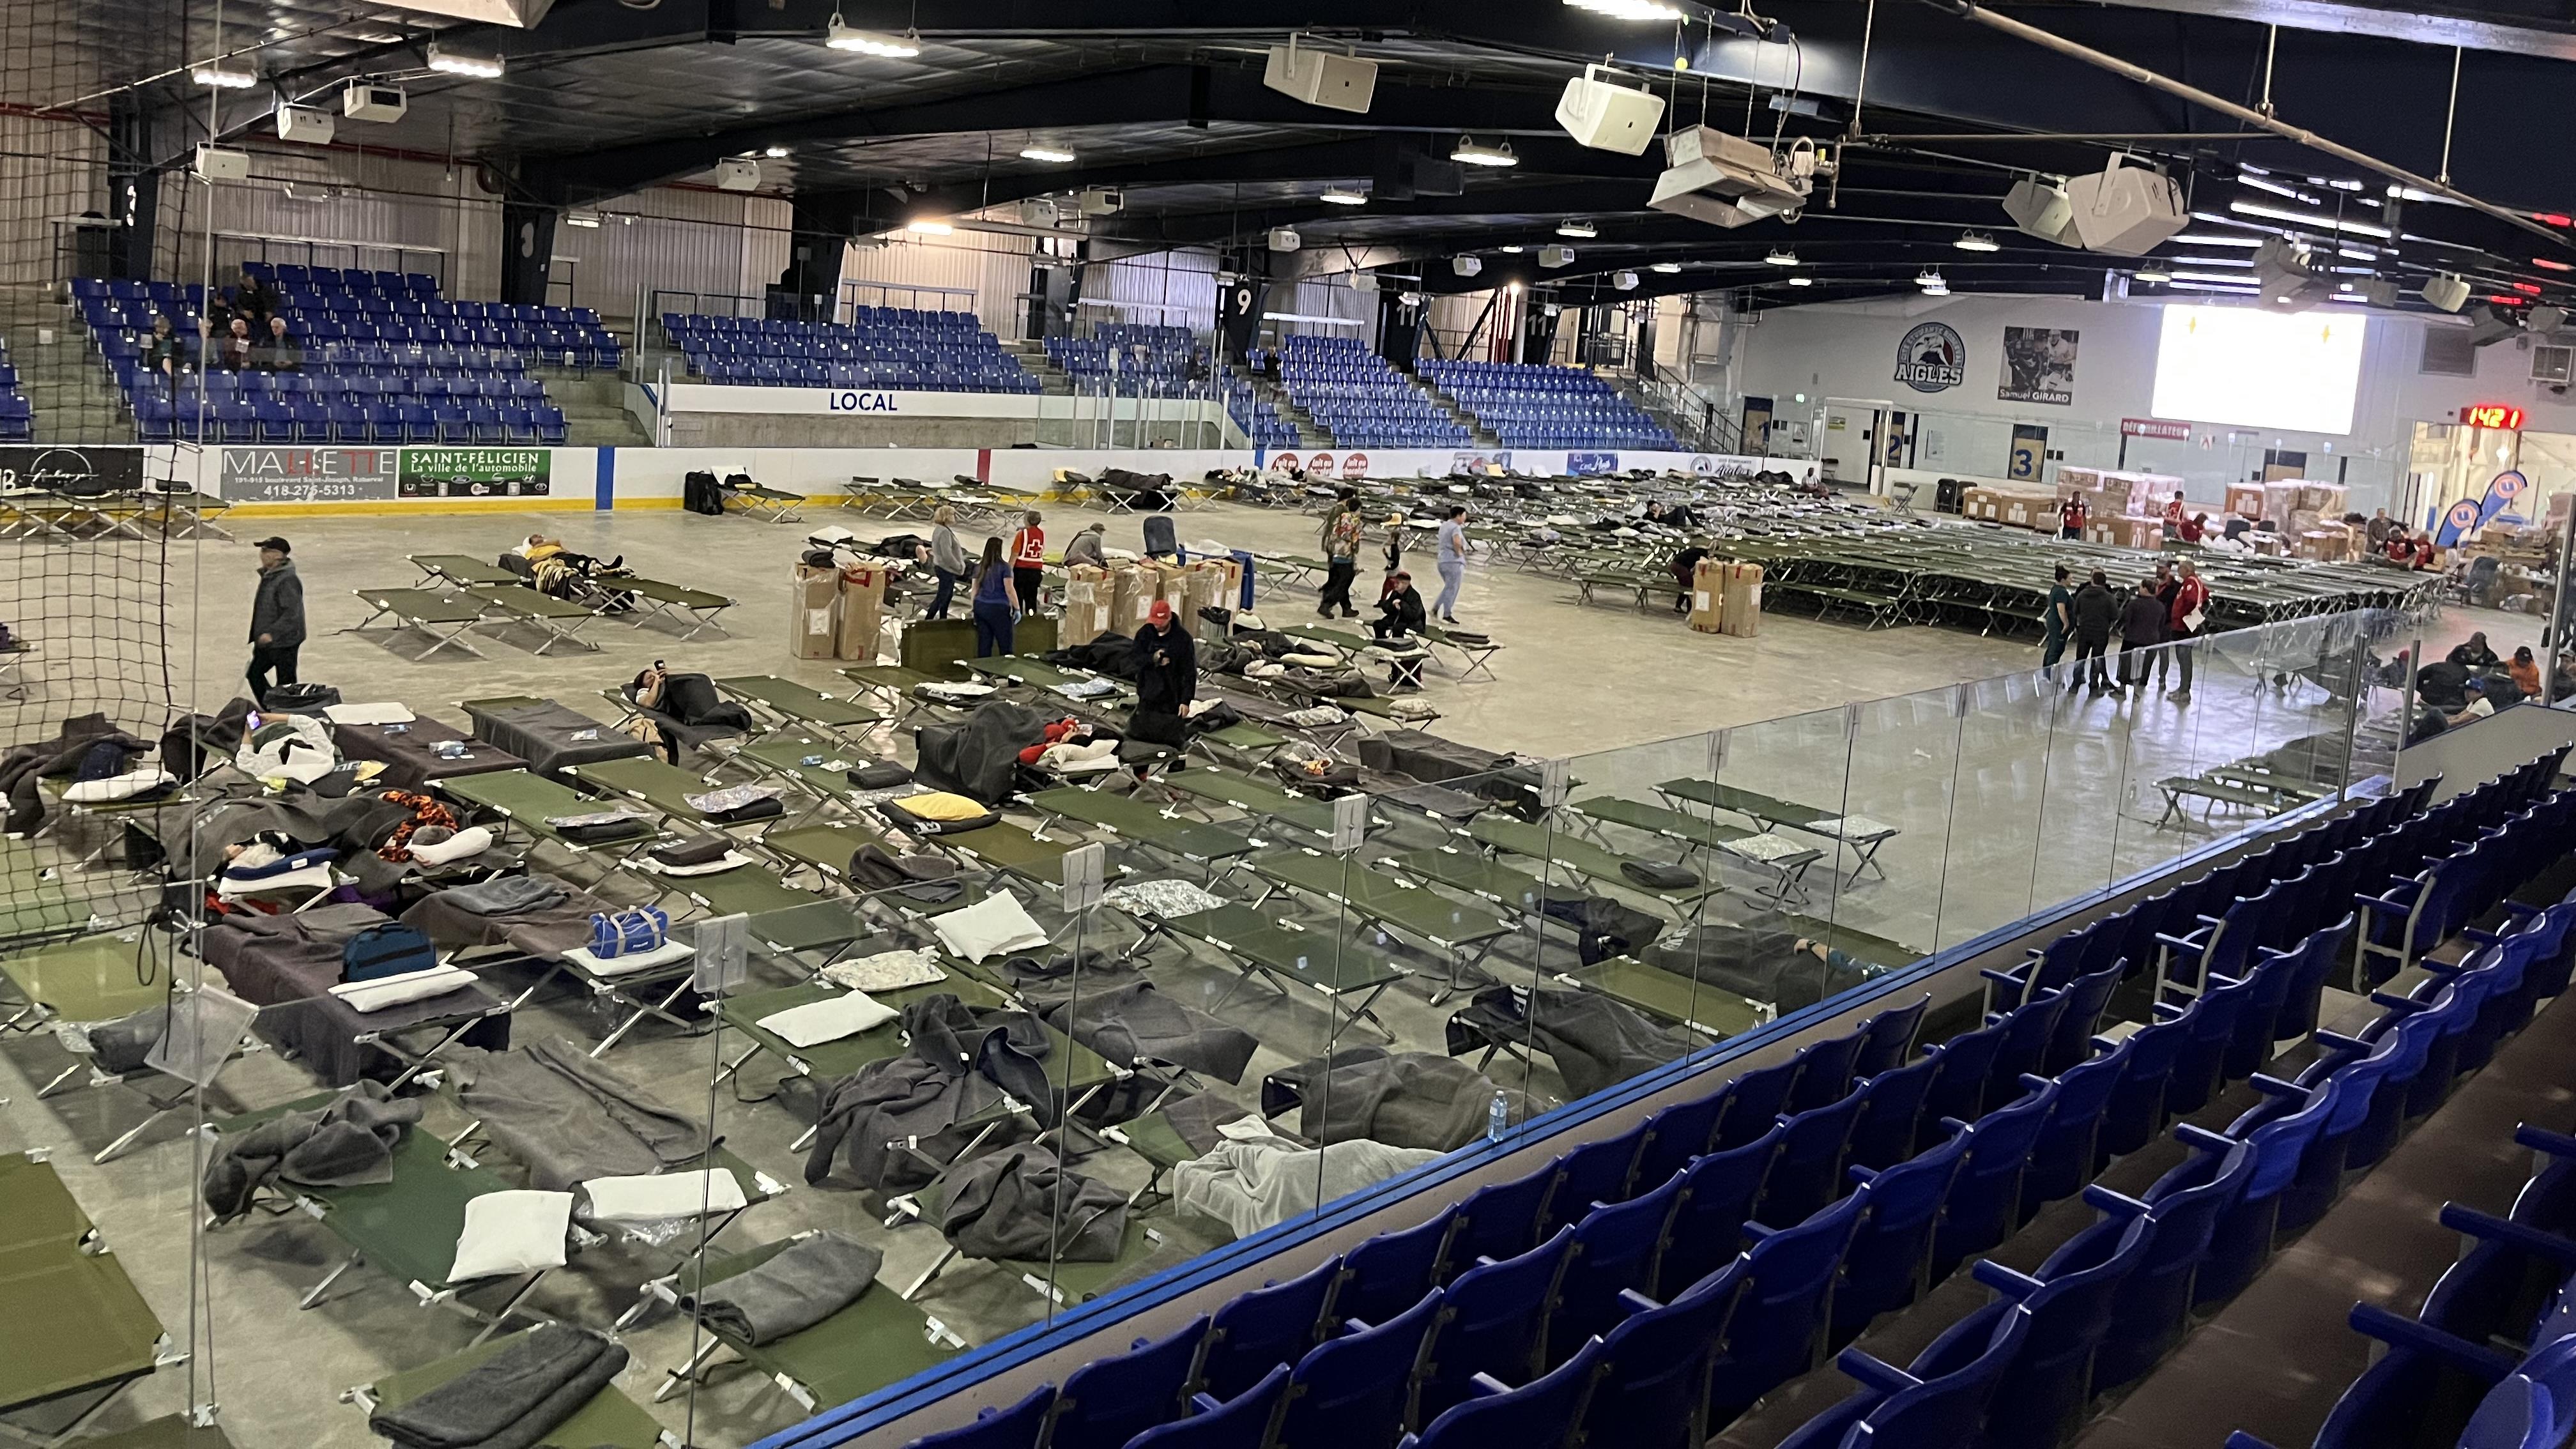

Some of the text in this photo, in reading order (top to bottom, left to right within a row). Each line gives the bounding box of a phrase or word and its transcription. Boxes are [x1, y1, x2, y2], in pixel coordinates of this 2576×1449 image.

[1238, 289, 1251, 315] 9
[1397, 302, 1416, 326] 11
[1896, 364, 1962, 385] AIGLES
[831, 392, 898, 411] LOCAL
[2000, 388, 2069, 403] Samuel GIRARD
[1888, 434, 1901, 459] 2
[411, 451, 539, 464] SAINT-FÉLICIEN
[1312, 458, 1323, 467] lait
[1347, 458, 1358, 466] lait
[2014, 449, 2032, 476] 3
[428, 464, 450, 472] ville
[455, 464, 468, 472] de
[472, 463, 537, 472] l'automobile
